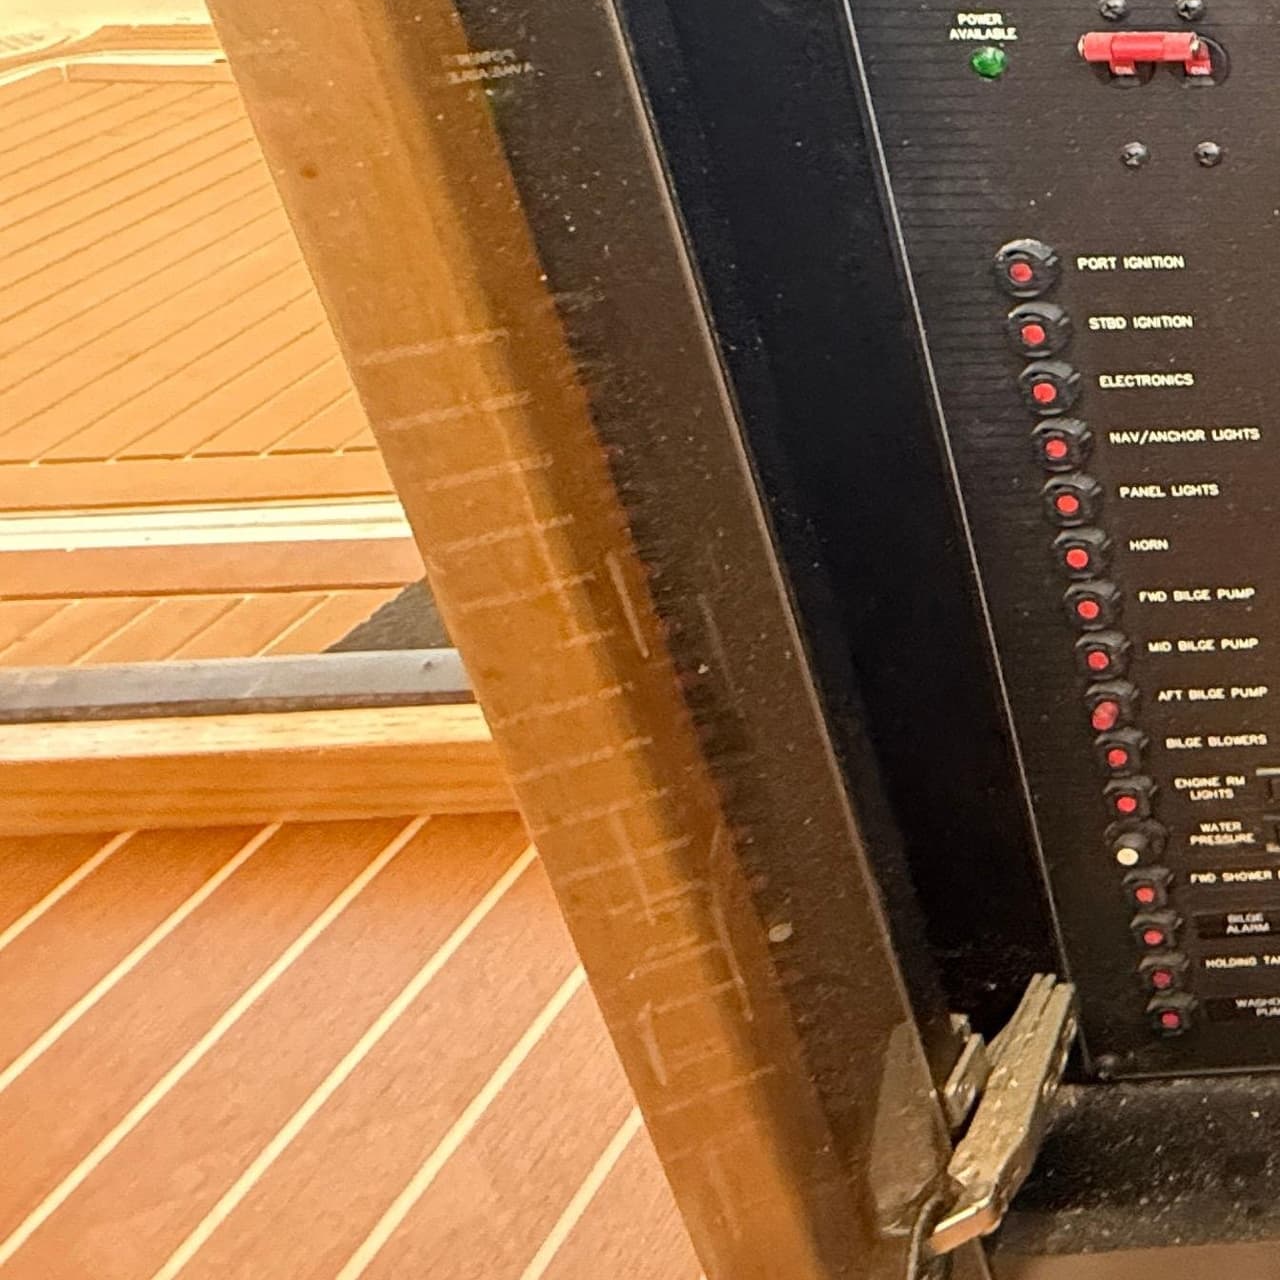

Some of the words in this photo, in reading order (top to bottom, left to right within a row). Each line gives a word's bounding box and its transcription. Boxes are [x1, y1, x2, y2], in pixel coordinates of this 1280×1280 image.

[1077, 257, 1116, 270] PORT
[1124, 256, 1184, 269] IGNITION
[1099, 373, 1194, 388] ELECTRONICS
[1110, 430, 1205, 445] NAV/ANCHOR
[1212, 429, 1260, 441] LIGHTS
[1120, 486, 1166, 498] PANEL
[1171, 484, 1219, 496] LIGHTS
[1130, 539, 1168, 551] HORN
[1158, 690, 1182, 701] AFT
[1189, 689, 1225, 700] BILGE
[1231, 687, 1268, 698] PUMP
[1222, 870, 1272, 882] SHOWER
